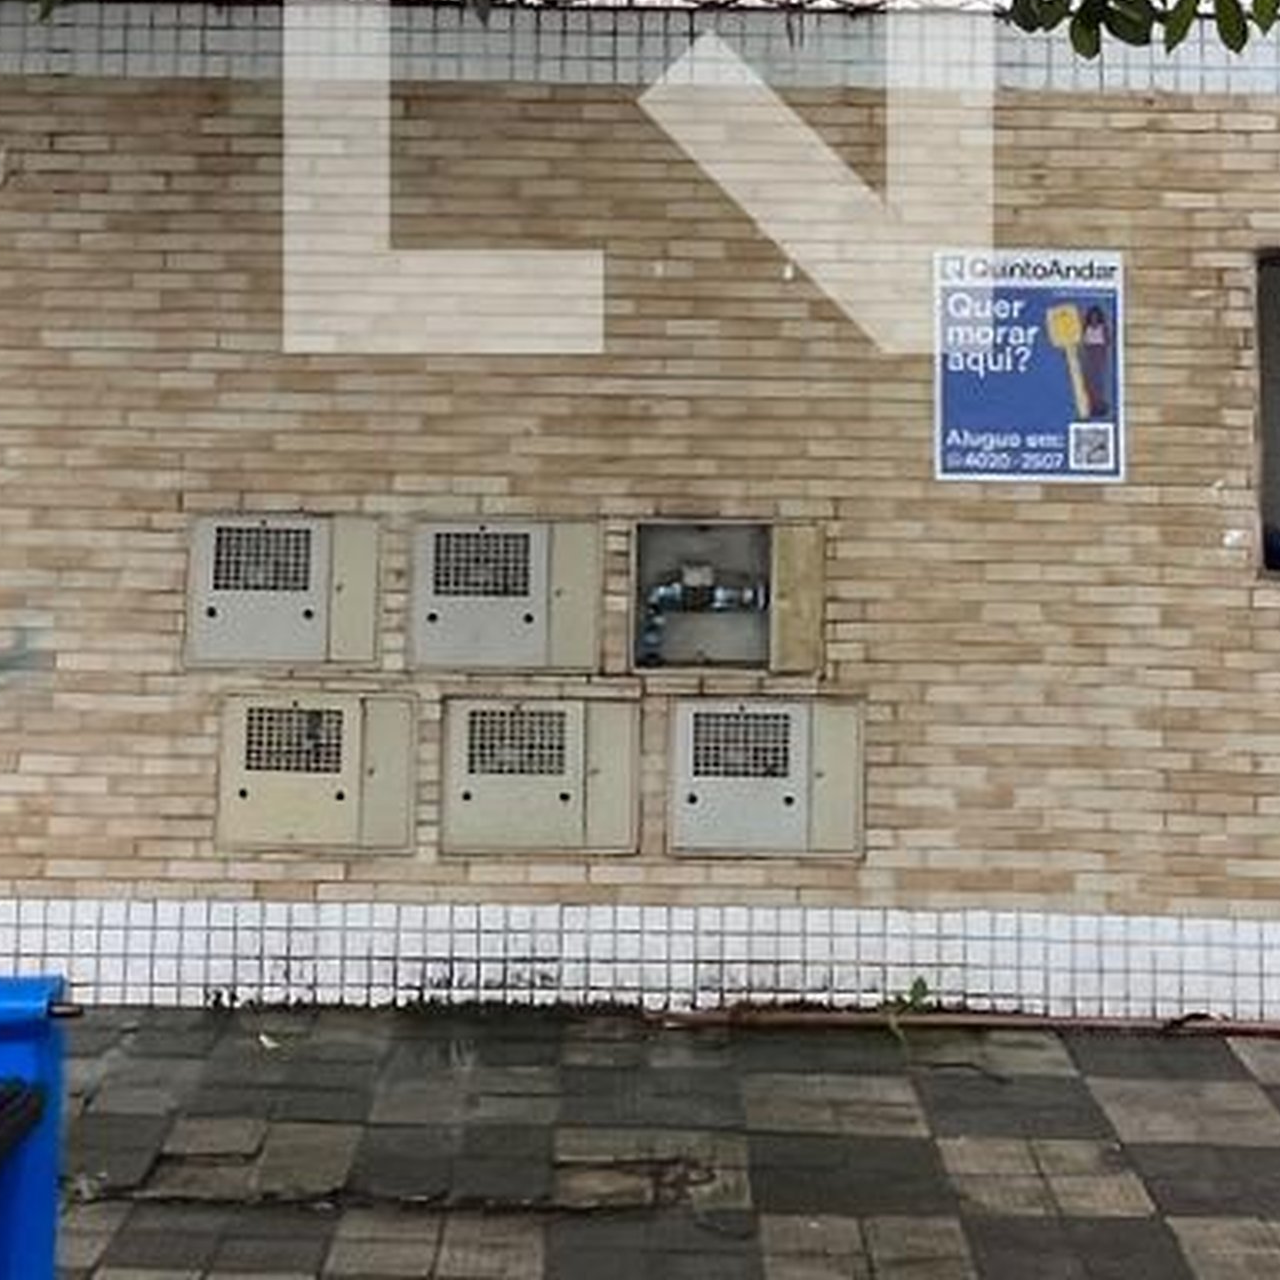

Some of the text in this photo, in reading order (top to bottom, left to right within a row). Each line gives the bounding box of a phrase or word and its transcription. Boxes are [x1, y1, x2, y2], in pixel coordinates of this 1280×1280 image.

[948, 293, 1025, 318] Quer
[948, 325, 1039, 345] morar
[948, 347, 1032, 378] aqui?
